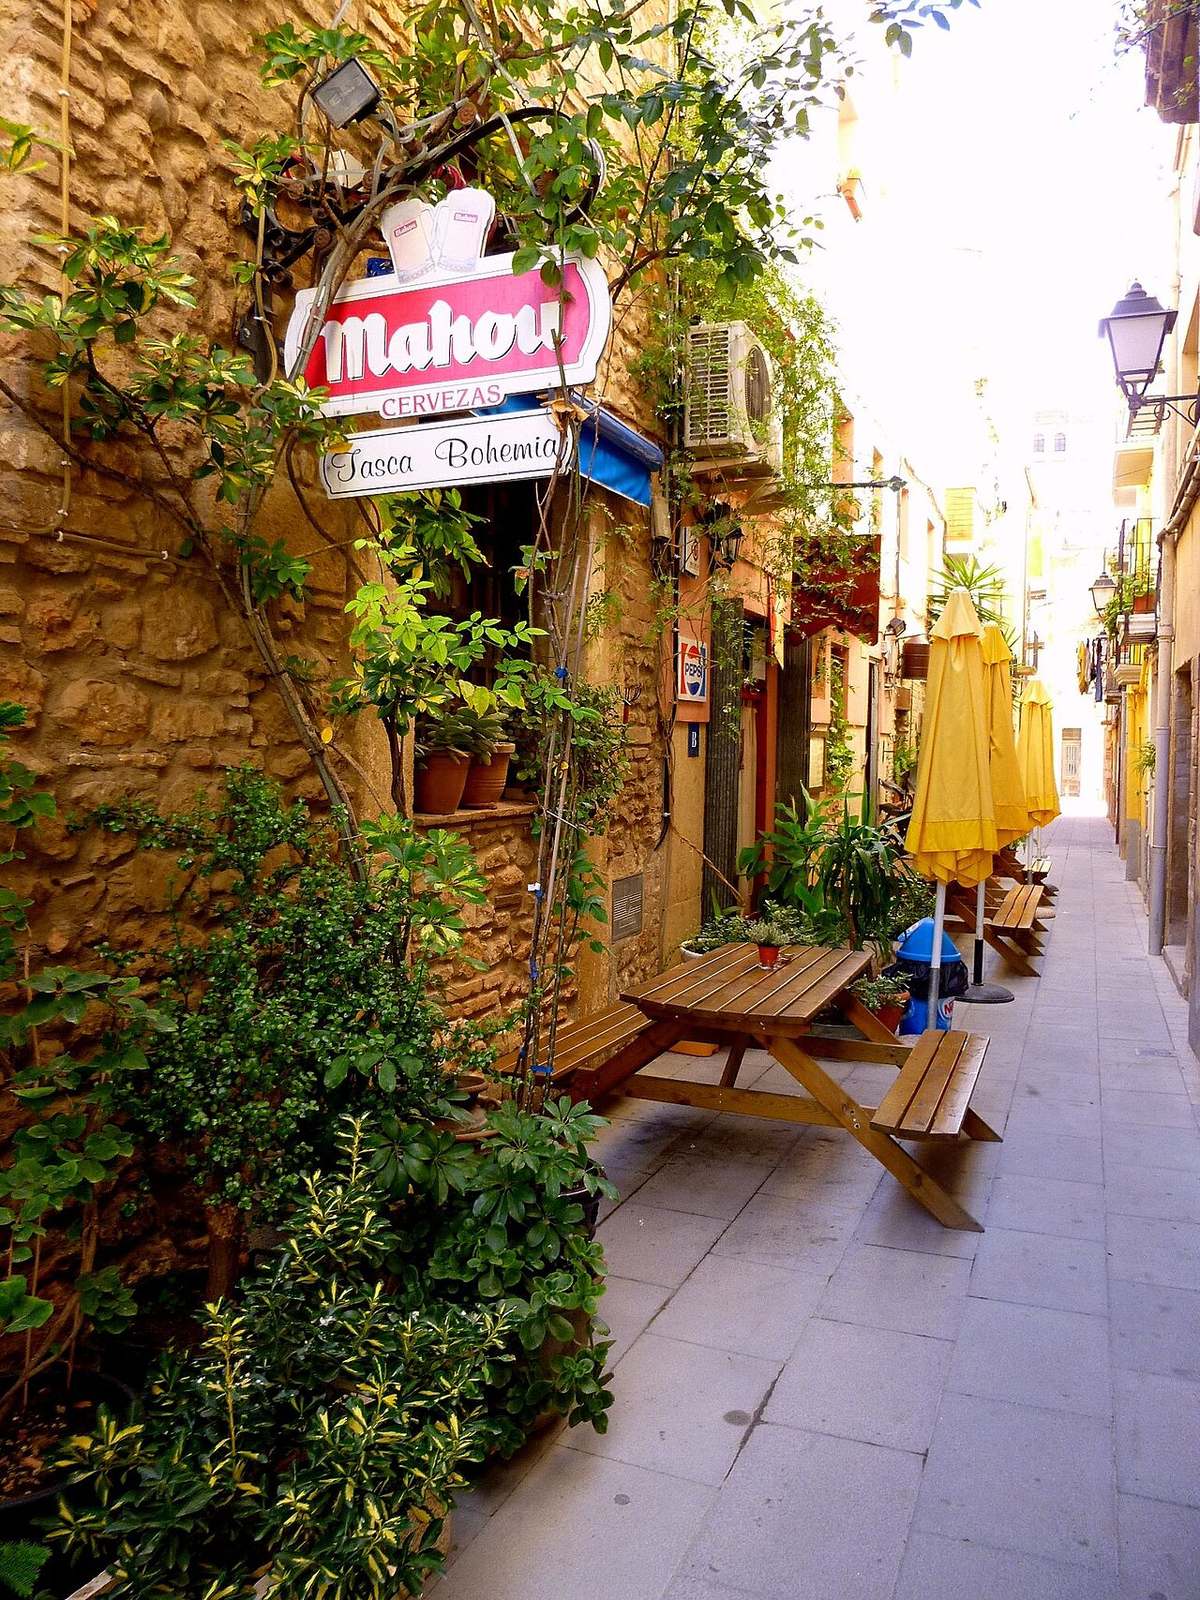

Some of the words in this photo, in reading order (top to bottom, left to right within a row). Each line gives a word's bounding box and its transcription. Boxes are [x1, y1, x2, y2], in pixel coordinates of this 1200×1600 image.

[319, 300, 566, 384] Mahou
[382, 384, 501, 416] CERVEZAS
[331, 448, 413, 482] Tasca
[434, 434, 559, 469] Bohemia
[685, 662, 703, 679] PEPSI
